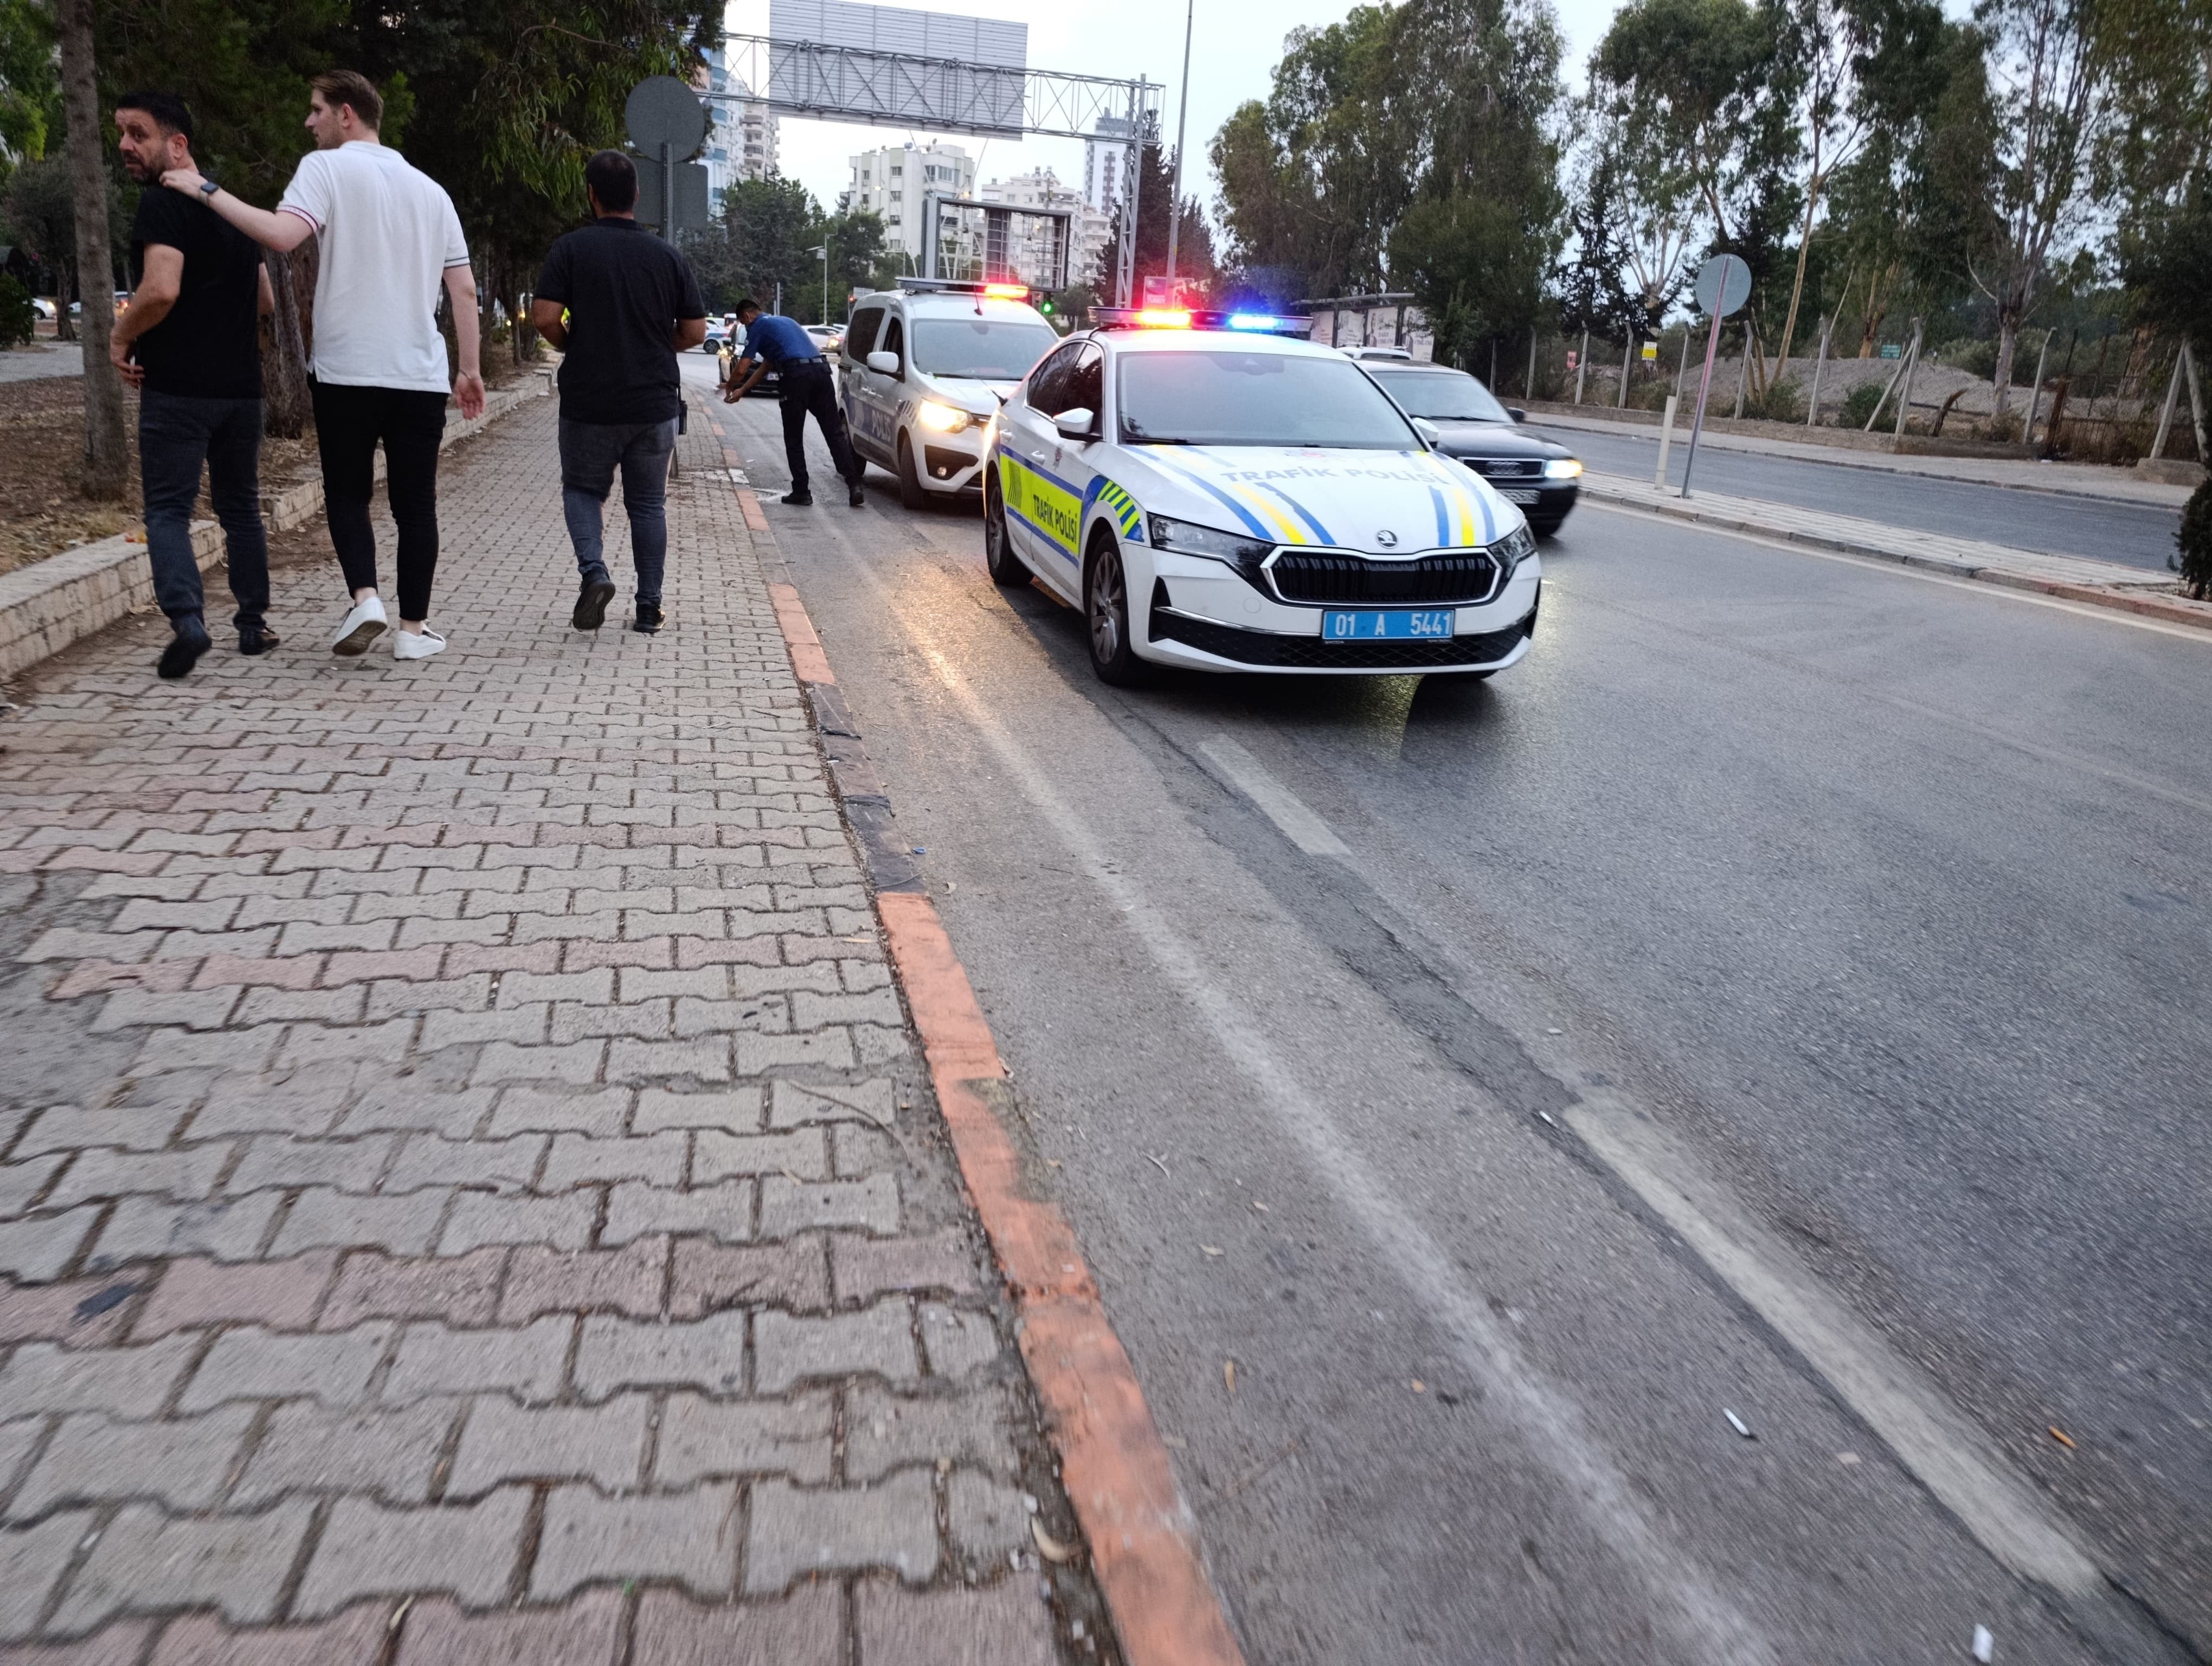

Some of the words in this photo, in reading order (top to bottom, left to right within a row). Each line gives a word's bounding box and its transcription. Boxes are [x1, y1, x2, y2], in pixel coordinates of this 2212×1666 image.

[1220, 466, 1338, 482] TRAFİK
[1344, 468, 1451, 485] POLİSİ
[1033, 494, 1054, 529] TRAFİK
[1055, 509, 1077, 544] POLİSİ
[1335, 614, 1355, 636] 01
[1374, 613, 1386, 636] A
[1410, 613, 1451, 635] 5441
